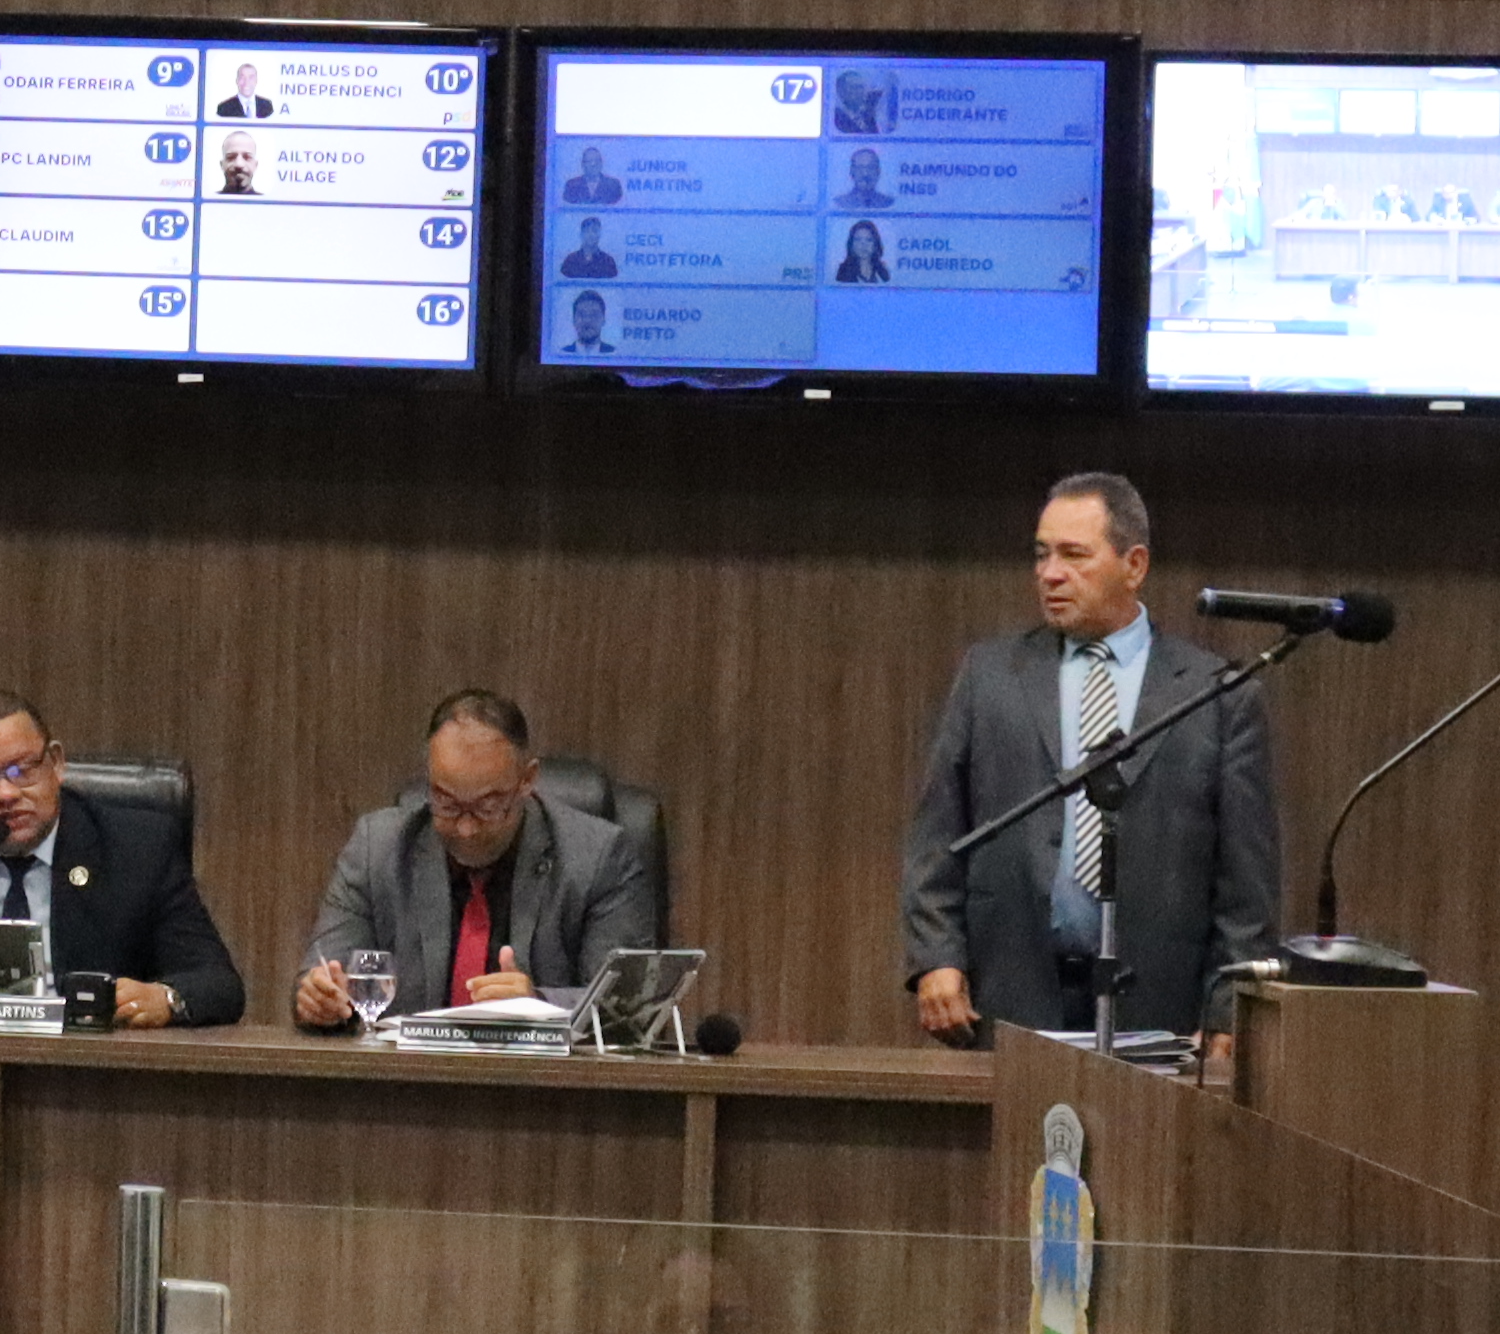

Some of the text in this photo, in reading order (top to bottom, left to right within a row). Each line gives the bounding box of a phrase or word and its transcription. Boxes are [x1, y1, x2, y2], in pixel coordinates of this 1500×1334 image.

[280, 64, 377, 77] MARLUS DO
[4, 76, 135, 91] ODAIR FERREIRA
[279, 103, 290, 114] A
[1, 153, 91, 166] PC LANDIM
[278, 150, 365, 164] AILTON DO
[278, 170, 337, 183] VILAGE
[994, 165, 1017, 177] DO
[0, 229, 74, 242] CLAUDIM
[403, 1027, 450, 1038] MARLUS
[453, 1029, 470, 1039] DO
